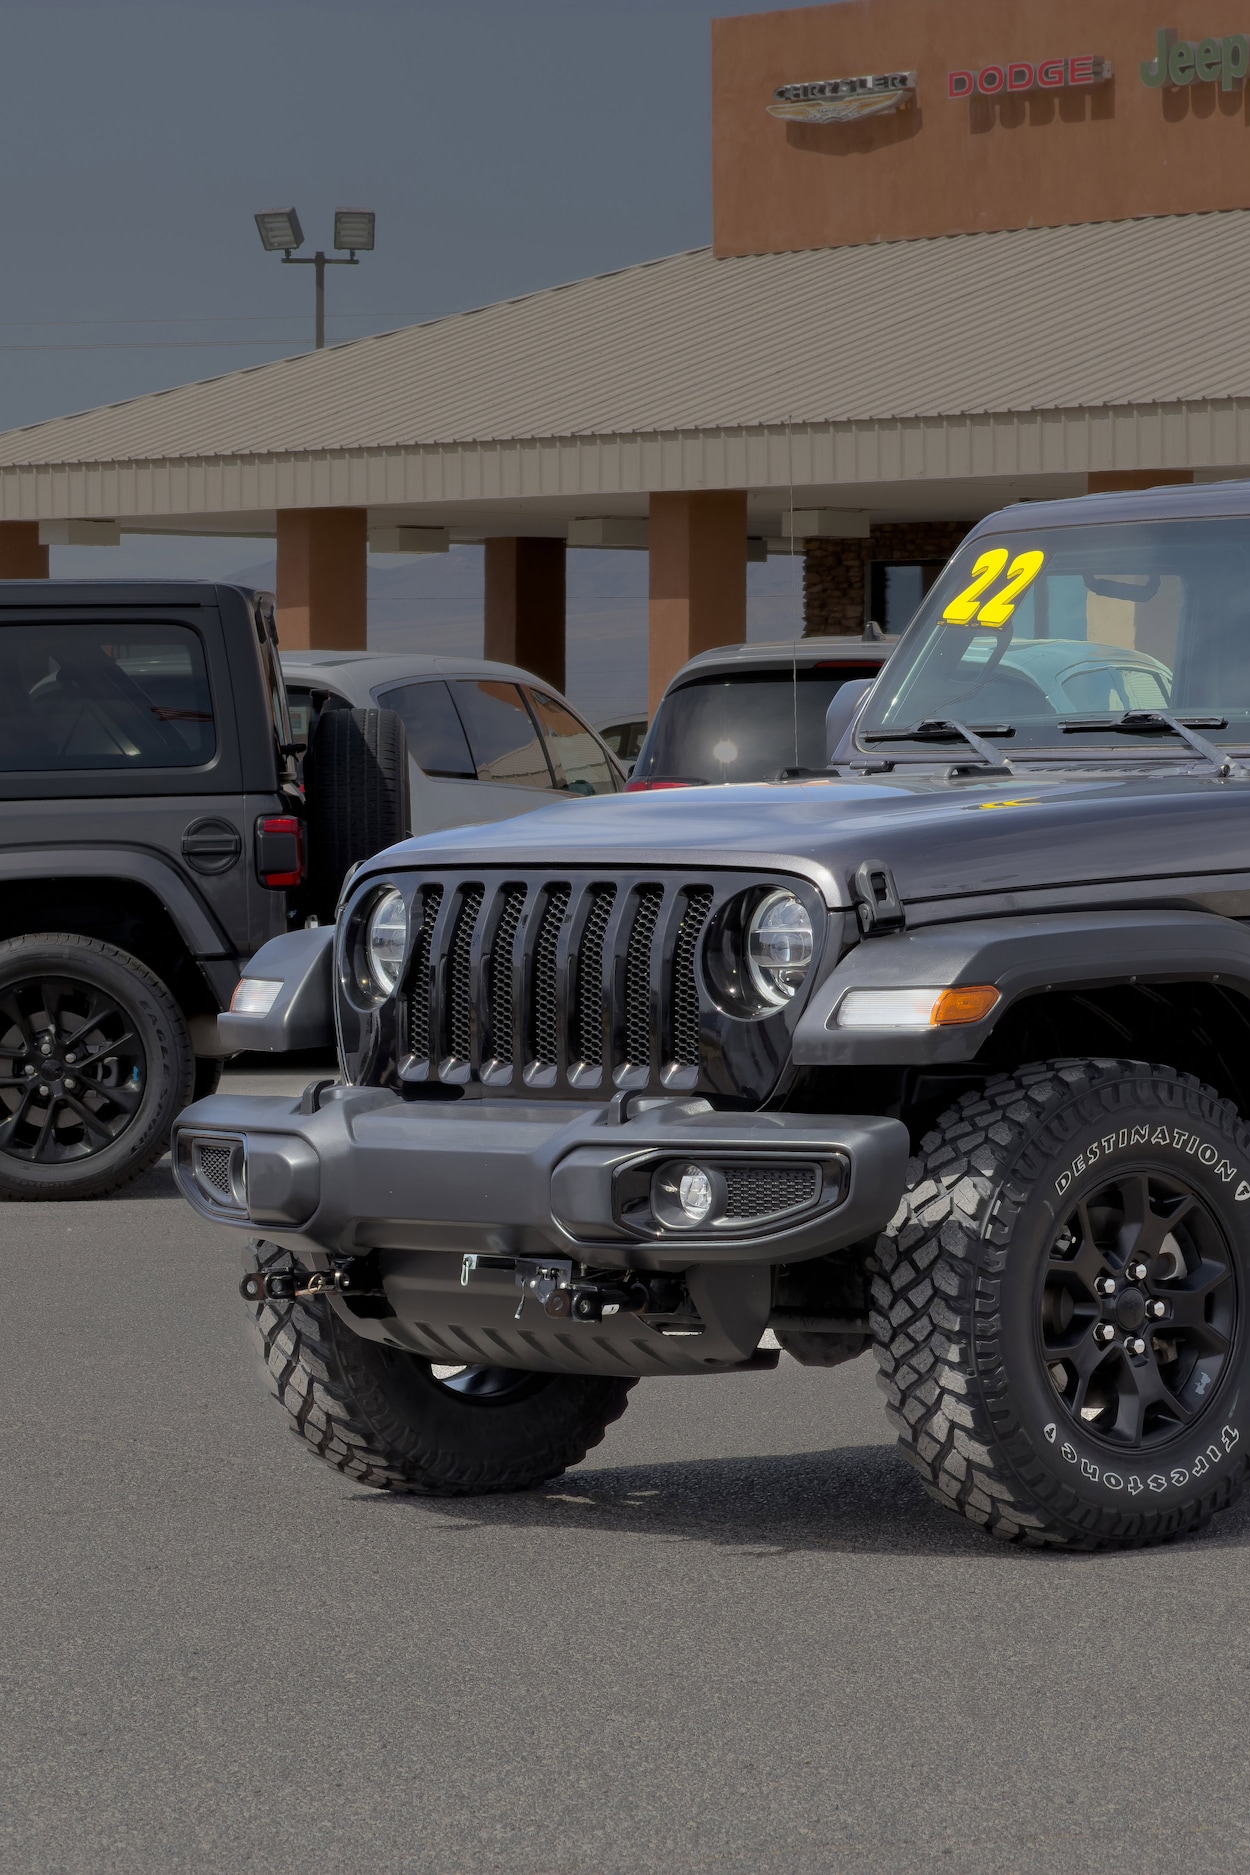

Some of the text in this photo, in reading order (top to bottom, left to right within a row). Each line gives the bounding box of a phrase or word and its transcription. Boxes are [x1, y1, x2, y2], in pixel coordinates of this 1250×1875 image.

[773, 72, 912, 101] CHRYSLER
[947, 54, 1095, 99] DODGE
[1140, 27, 1249, 92] Jeep
[942, 547, 1045, 628] 22
[1054, 1124, 1238, 1196] DESTINATION
[1061, 1425, 1240, 1496] Firestone
